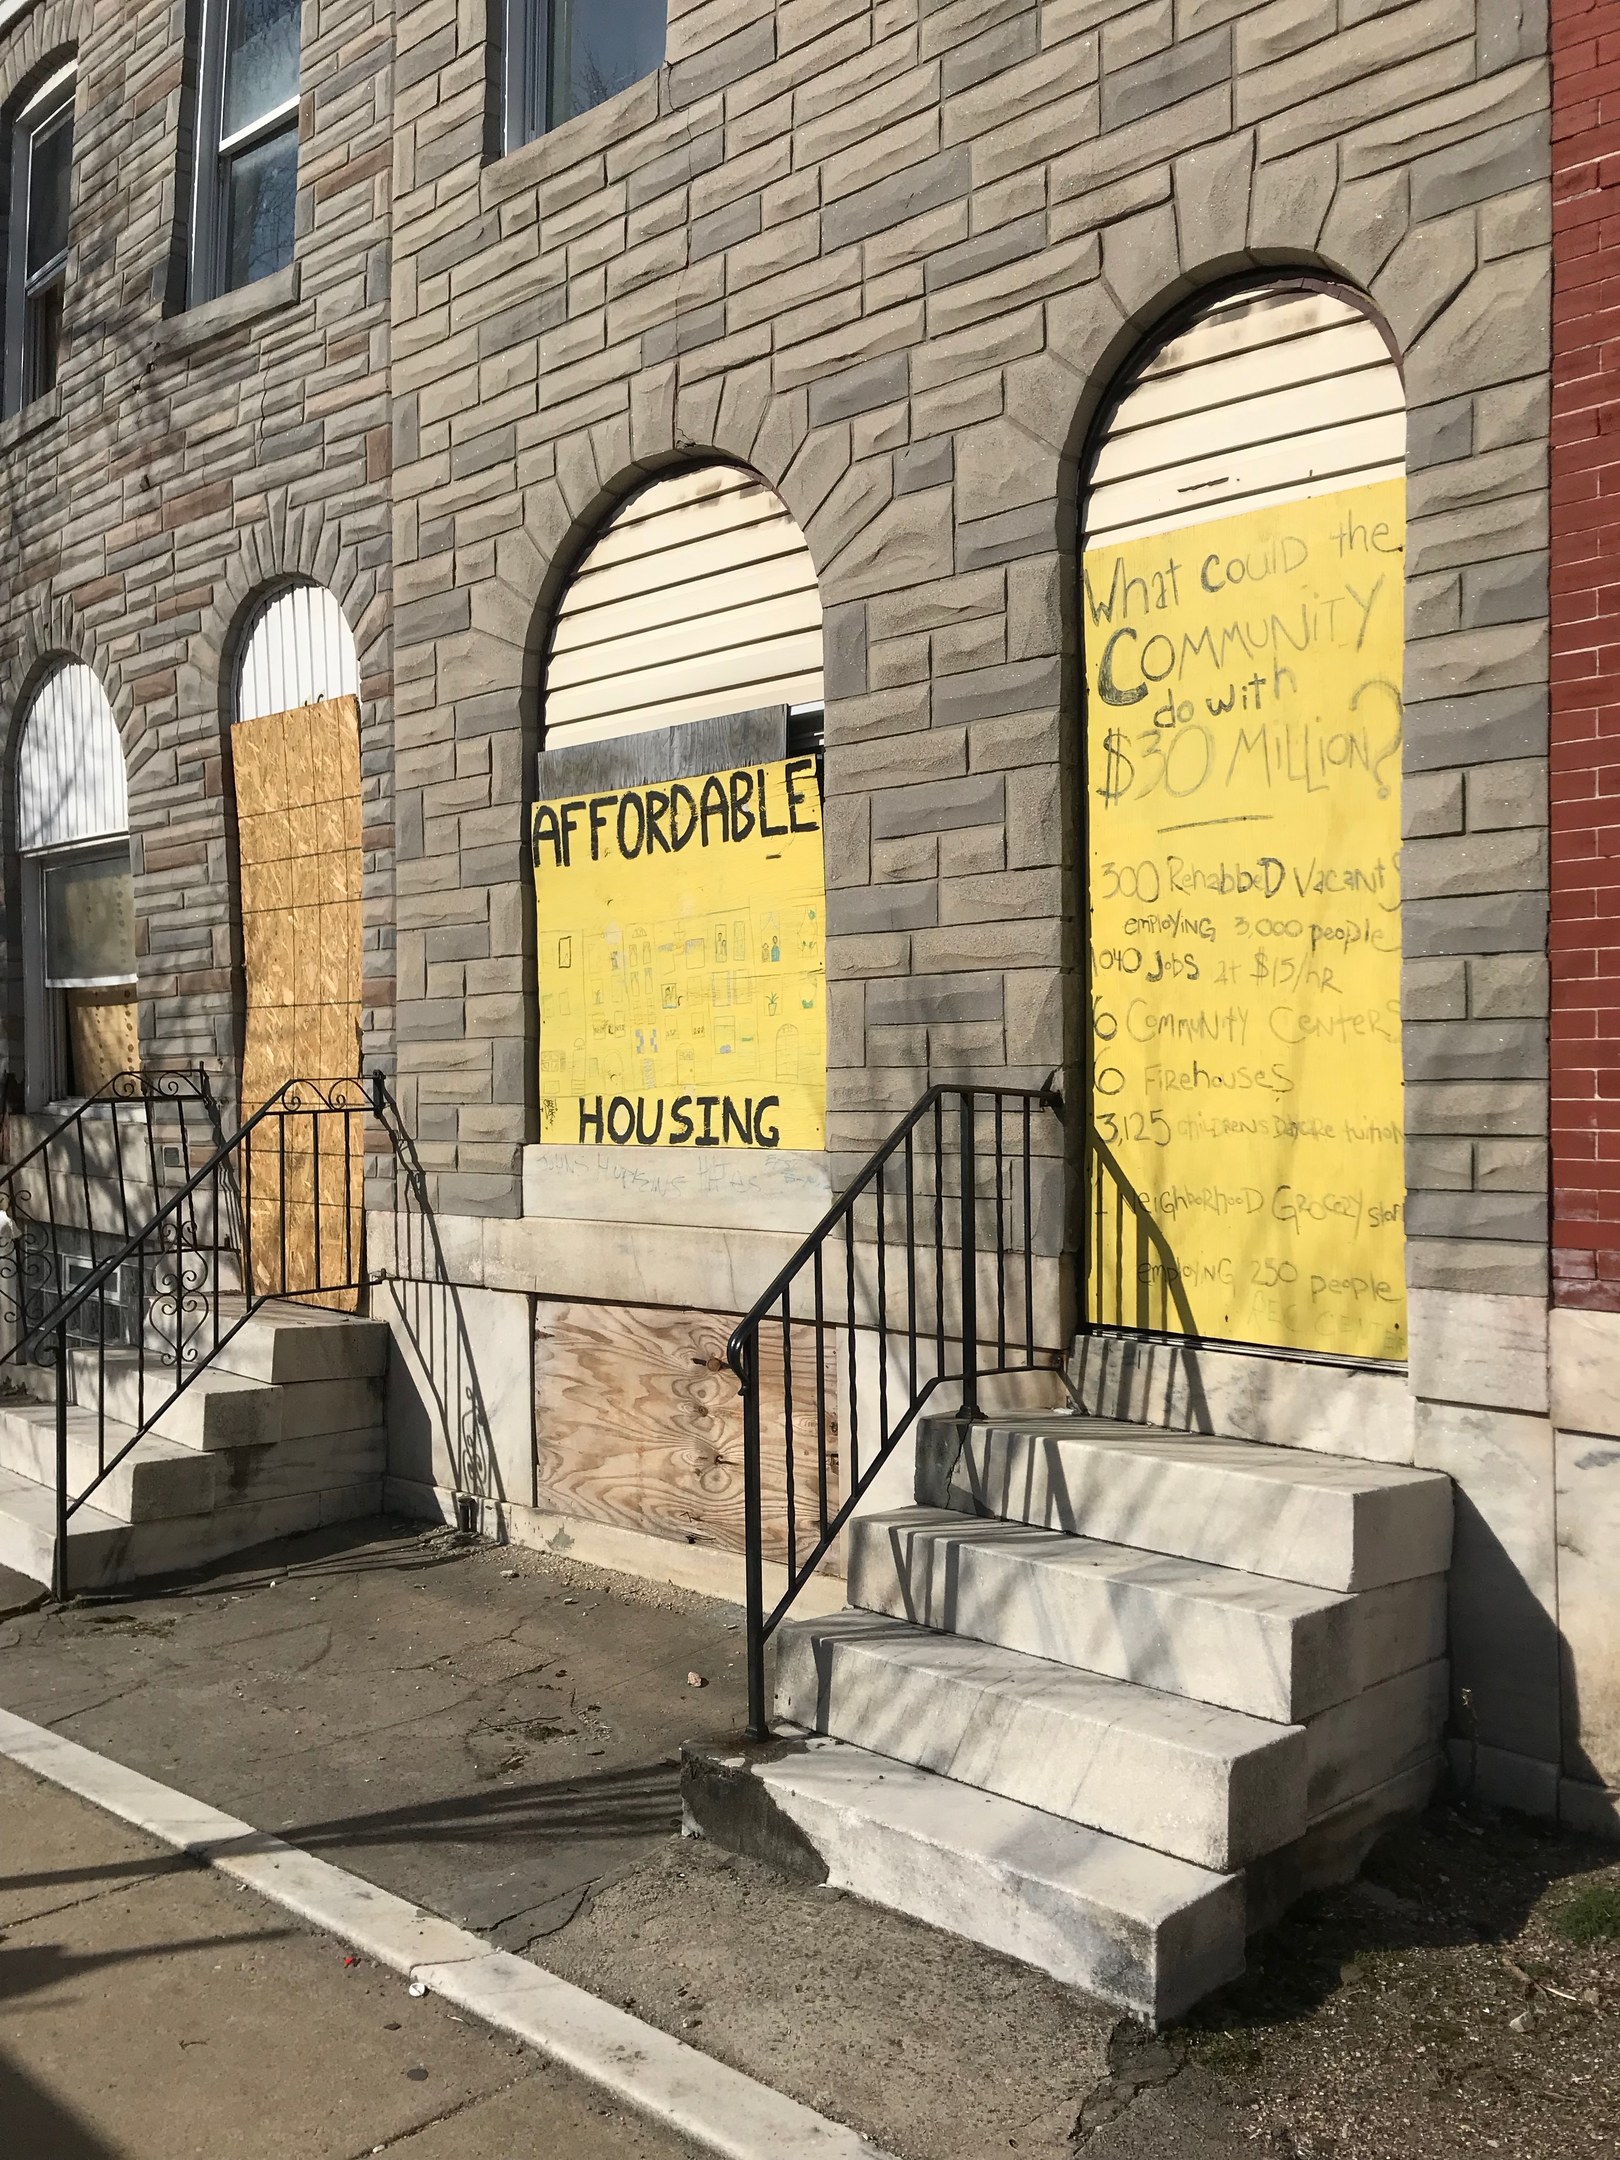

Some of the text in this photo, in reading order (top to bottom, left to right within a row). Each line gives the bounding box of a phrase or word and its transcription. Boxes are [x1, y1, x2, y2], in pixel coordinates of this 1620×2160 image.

[1083, 556, 1182, 627] What
[1328, 507, 1404, 558] the
[1152, 655, 1297, 729] do with
[1094, 724, 1215, 811] $30
[533, 759, 821, 868] AFFORDABLE
[1101, 860, 1160, 903] 300
[1234, 915, 1303, 939] 3,000
[1310, 917, 1403, 956] people
[579, 1095, 781, 1148] HOUSING
[1096, 1108, 1172, 1147] 3,125
[1251, 1259, 1298, 1288] 250
[1310, 1274, 1405, 1303] people
